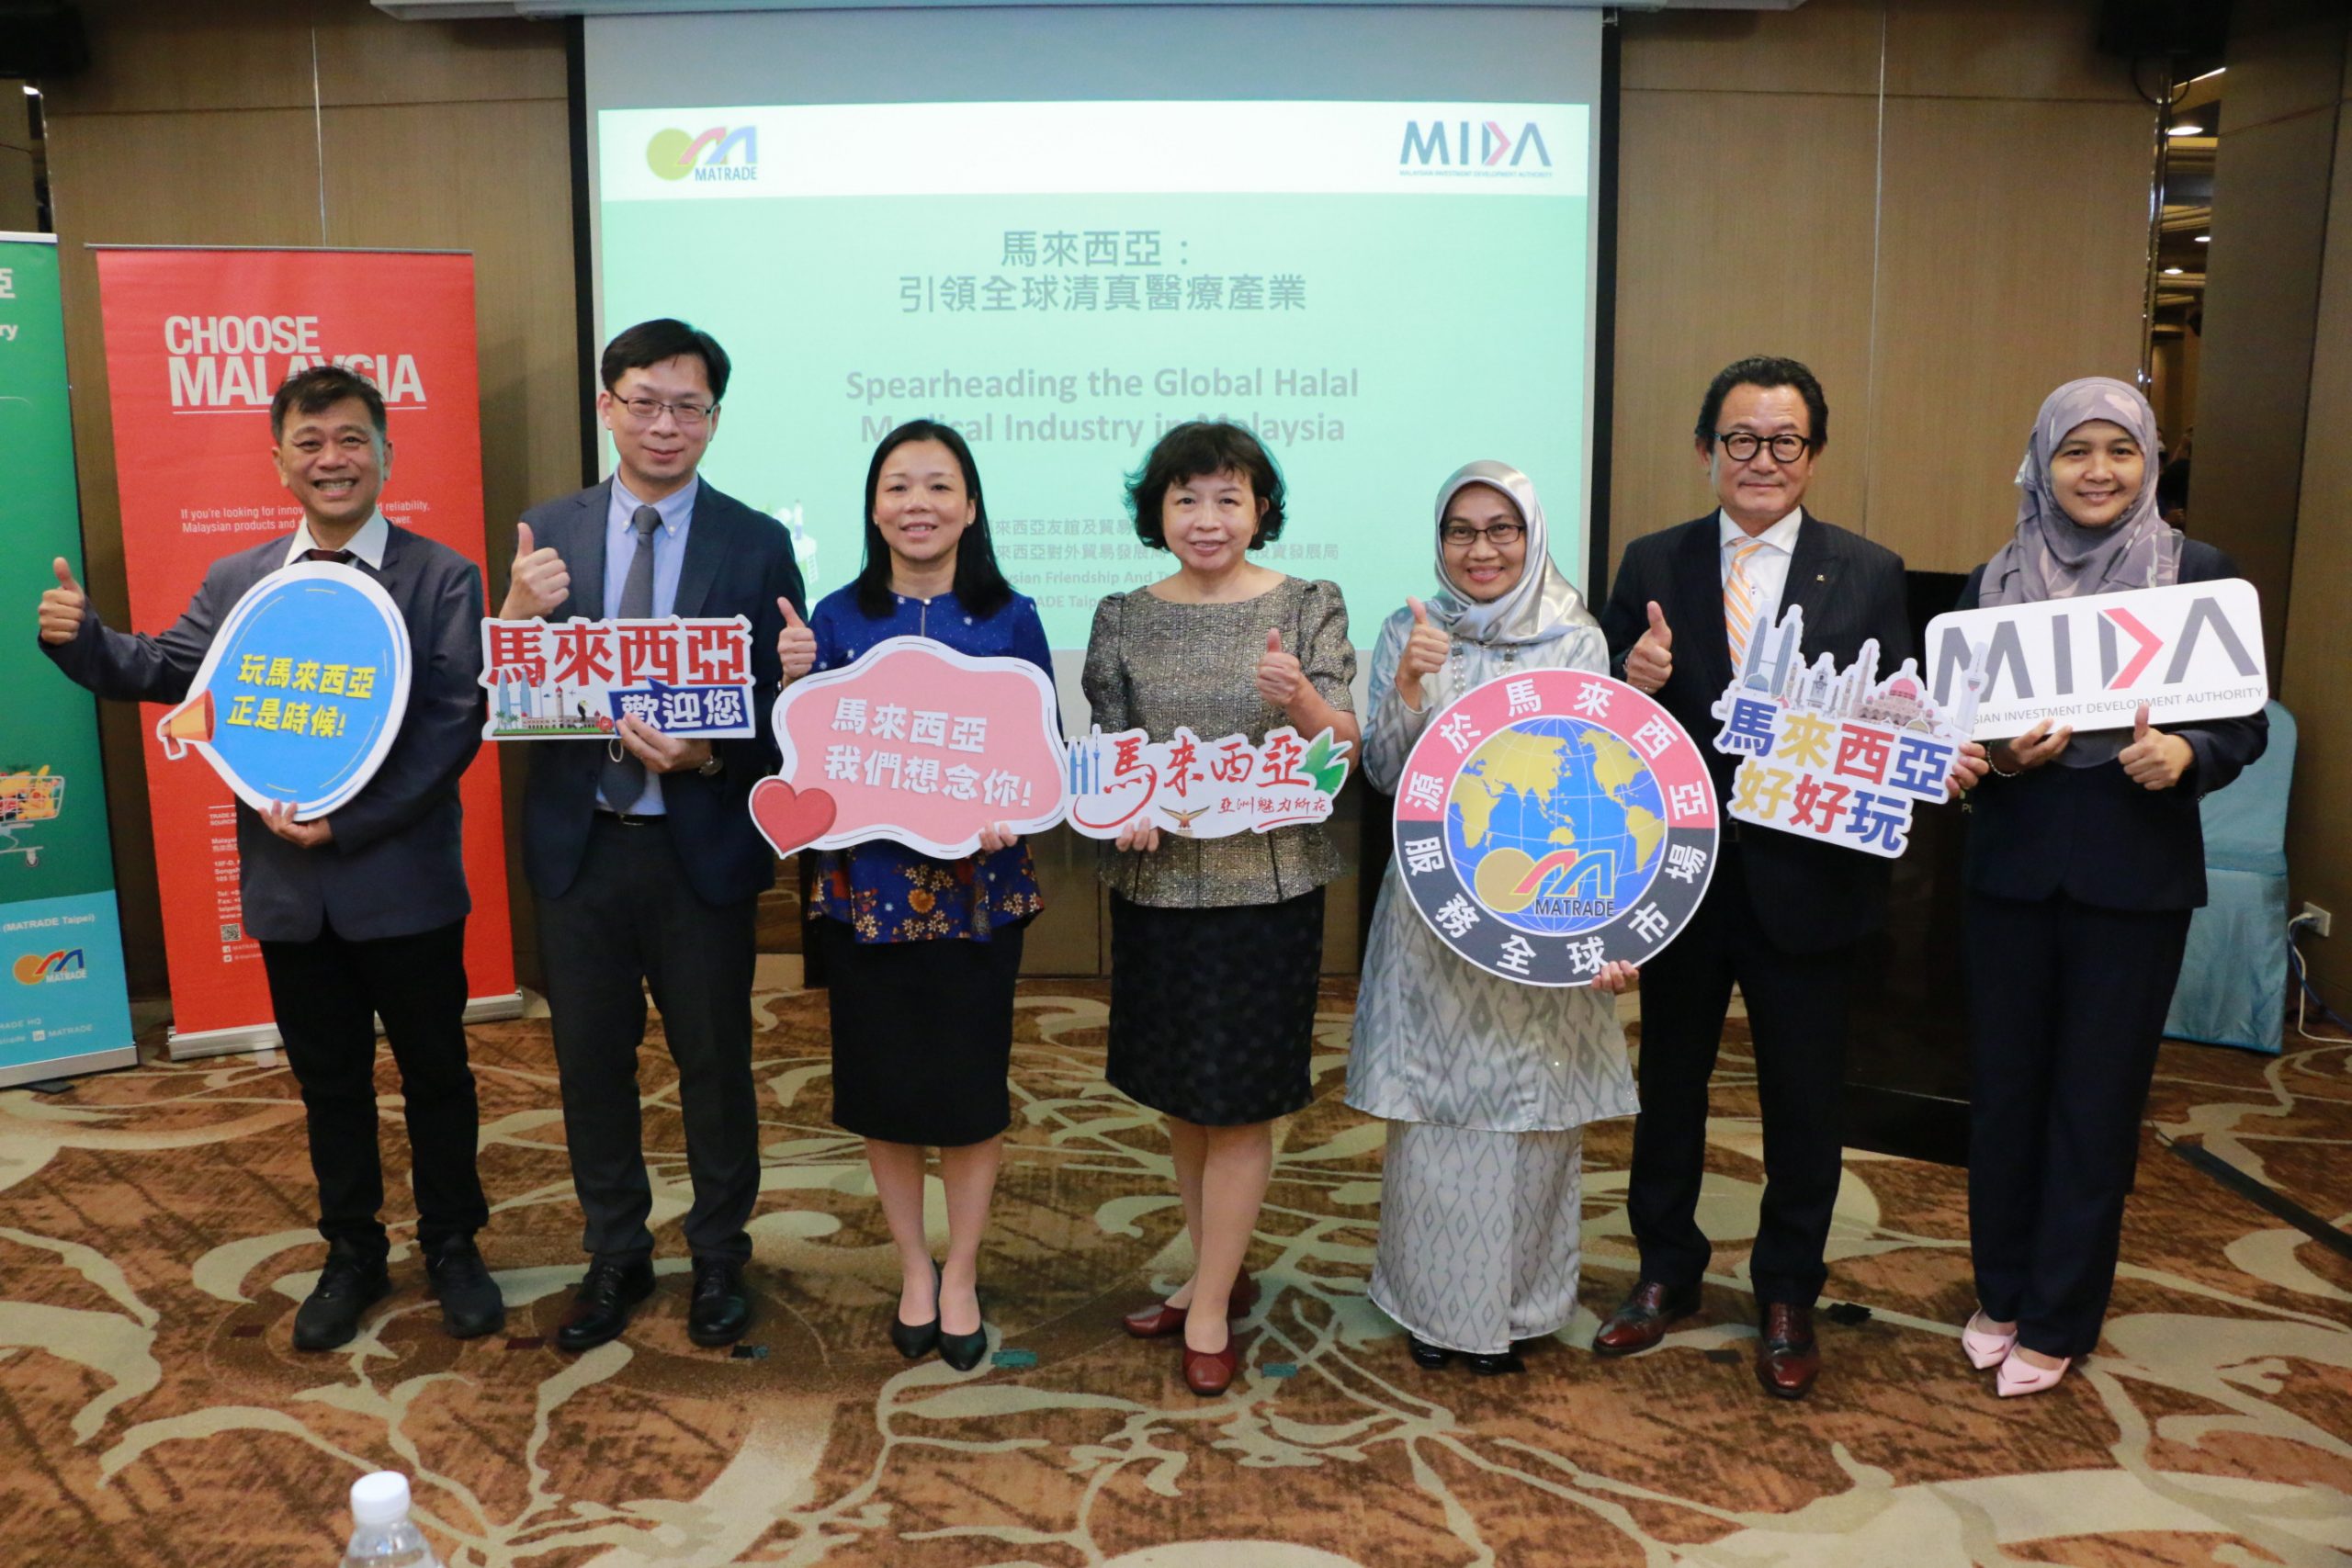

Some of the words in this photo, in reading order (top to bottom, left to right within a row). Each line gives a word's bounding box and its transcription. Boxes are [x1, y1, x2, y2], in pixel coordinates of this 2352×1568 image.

[1400, 120, 1553, 166] MIDA
[695, 166, 757, 181] MATRADE
[899, 274, 1306, 313] 引領全球清真醫療產業
[164, 316, 321, 355] CHOOSE
[846, 368, 1078, 405] Spearheading
[1088, 367, 1143, 397] the
[1154, 367, 1262, 397] Global
[1275, 367, 1358, 397] Halal
[1005, 412, 1144, 447] Industry
[180, 509, 188, 519] If
[191, 507, 220, 521] you're
[223, 506, 259, 519] looking
[262, 505, 275, 516] for
[182, 522, 231, 534] Malaysian
[234, 520, 276, 532] products
[278, 520, 295, 529] and
[990, 519, 1133, 536] 來西亞友誼及貿易
[1046, 571, 1120, 585] Friendship
[1125, 571, 1152, 583] And
[486, 623, 749, 687] 馬來西亞
[1933, 597, 2260, 706] MIDA
[237, 654, 377, 699] 玩馬來西亞
[226, 695, 346, 739] 正是時候!
[620, 689, 743, 730] 歡迎您
[2005, 705, 2082, 721] INVESTMENT
[2187, 686, 2264, 704] AUTHORITY
[831, 697, 988, 753] 馬來西亞
[1101, 734, 1311, 799] 馬來西亞
[1404, 678, 1709, 820] 源於馬來西亞
[1719, 697, 1953, 797] 馬來西亞
[824, 744, 1033, 808] 我們想念你!
[1217, 796, 1328, 816] 亞洲魅力所在
[1733, 760, 1907, 852] 好好玩
[3, 917, 59, 932] (MATRADE
[62, 913, 96, 925] Taipei)
[1404, 836, 1708, 976] 服務全球市場
[1535, 898, 1614, 917] MATRADE
[46, 970, 87, 982] MATRADE
